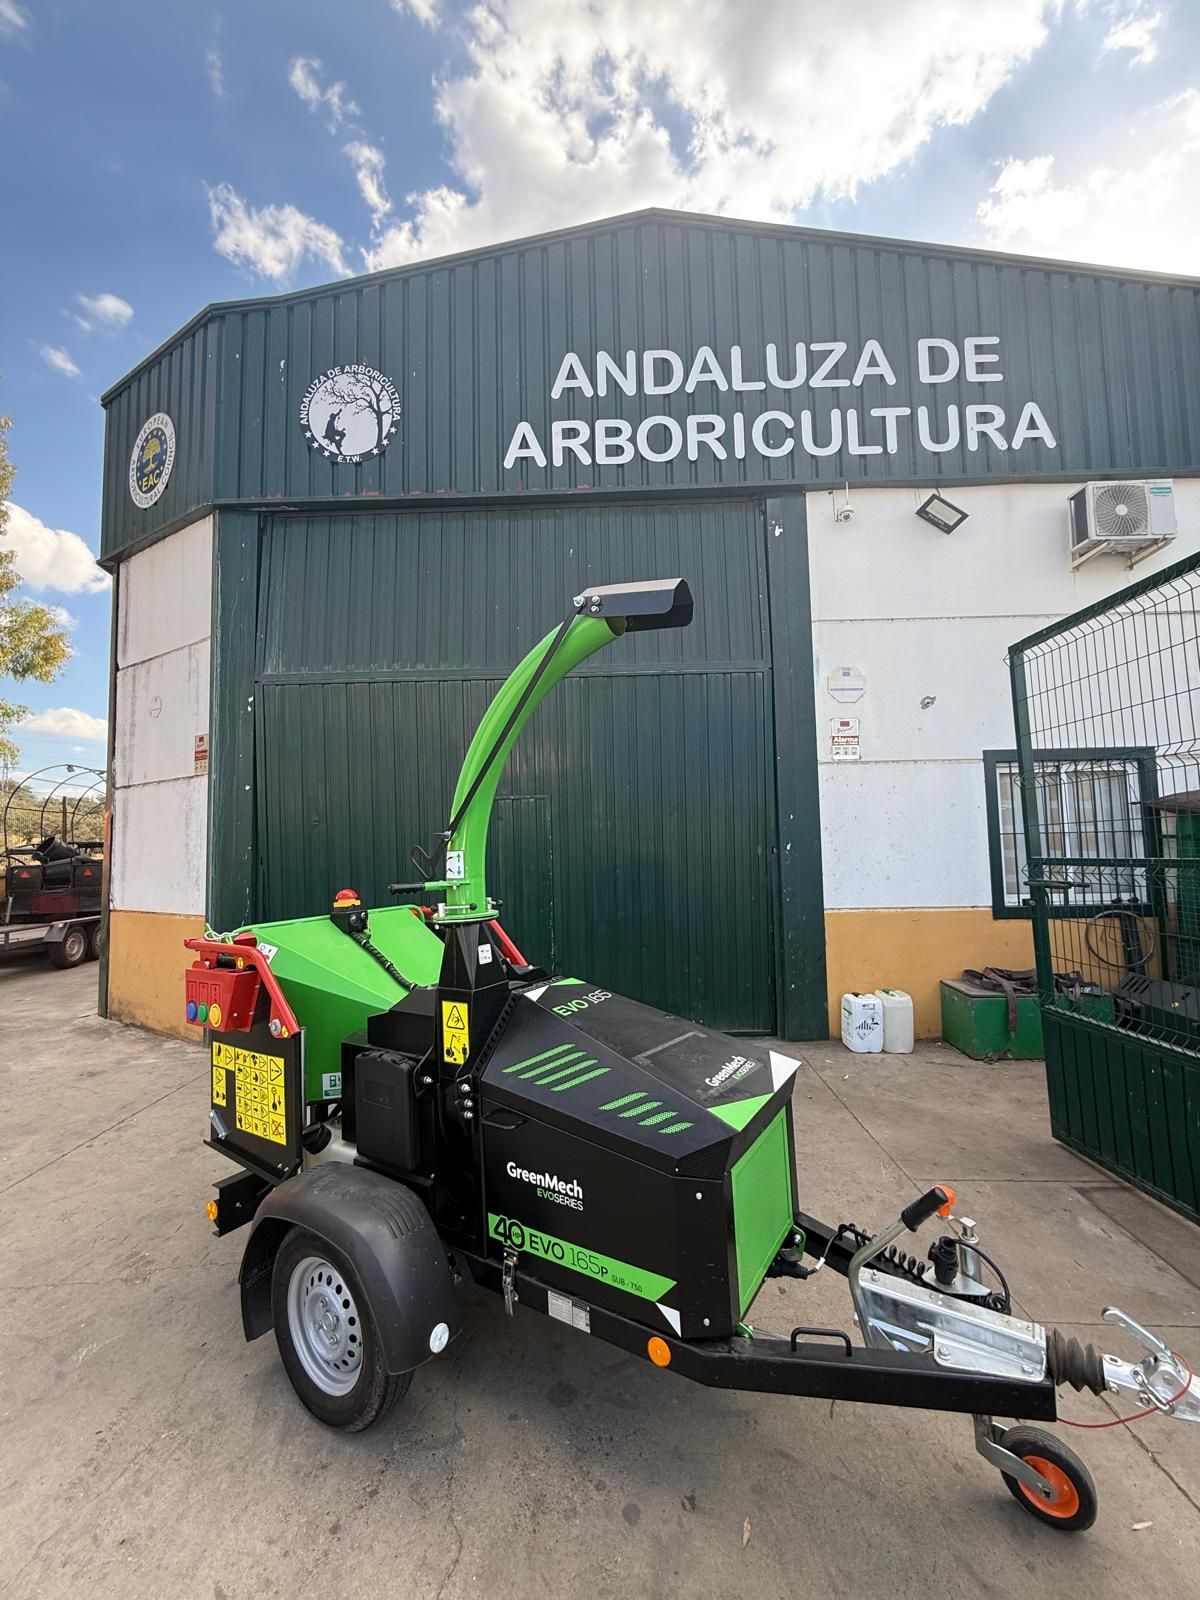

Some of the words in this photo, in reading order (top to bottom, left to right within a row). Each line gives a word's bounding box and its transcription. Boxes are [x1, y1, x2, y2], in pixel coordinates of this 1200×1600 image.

[551, 339, 896, 399] ANDALUZA
[917, 336, 1003, 384] DE
[300, 375, 327, 425] ANDALUZA
[327, 367, 341, 378] DE
[344, 364, 401, 421] ARBORICULTURA
[136, 416, 169, 448] EUROPEAN
[503, 402, 1057, 468] ARBORICULTURA
[162, 432, 174, 484] COUNCIL
[142, 469, 160, 492] EAC
[552, 1000, 589, 1016] EVO
[582, 989, 612, 1004] 165
[705, 1056, 747, 1086] GreenMech
[506, 1161, 583, 1199] GreenMech
[537, 1188, 584, 1211] EVOSERIES
[493, 1215, 526, 1250] 40
[512, 1230, 521, 1239] HP
[529, 1232, 565, 1261] EVO
